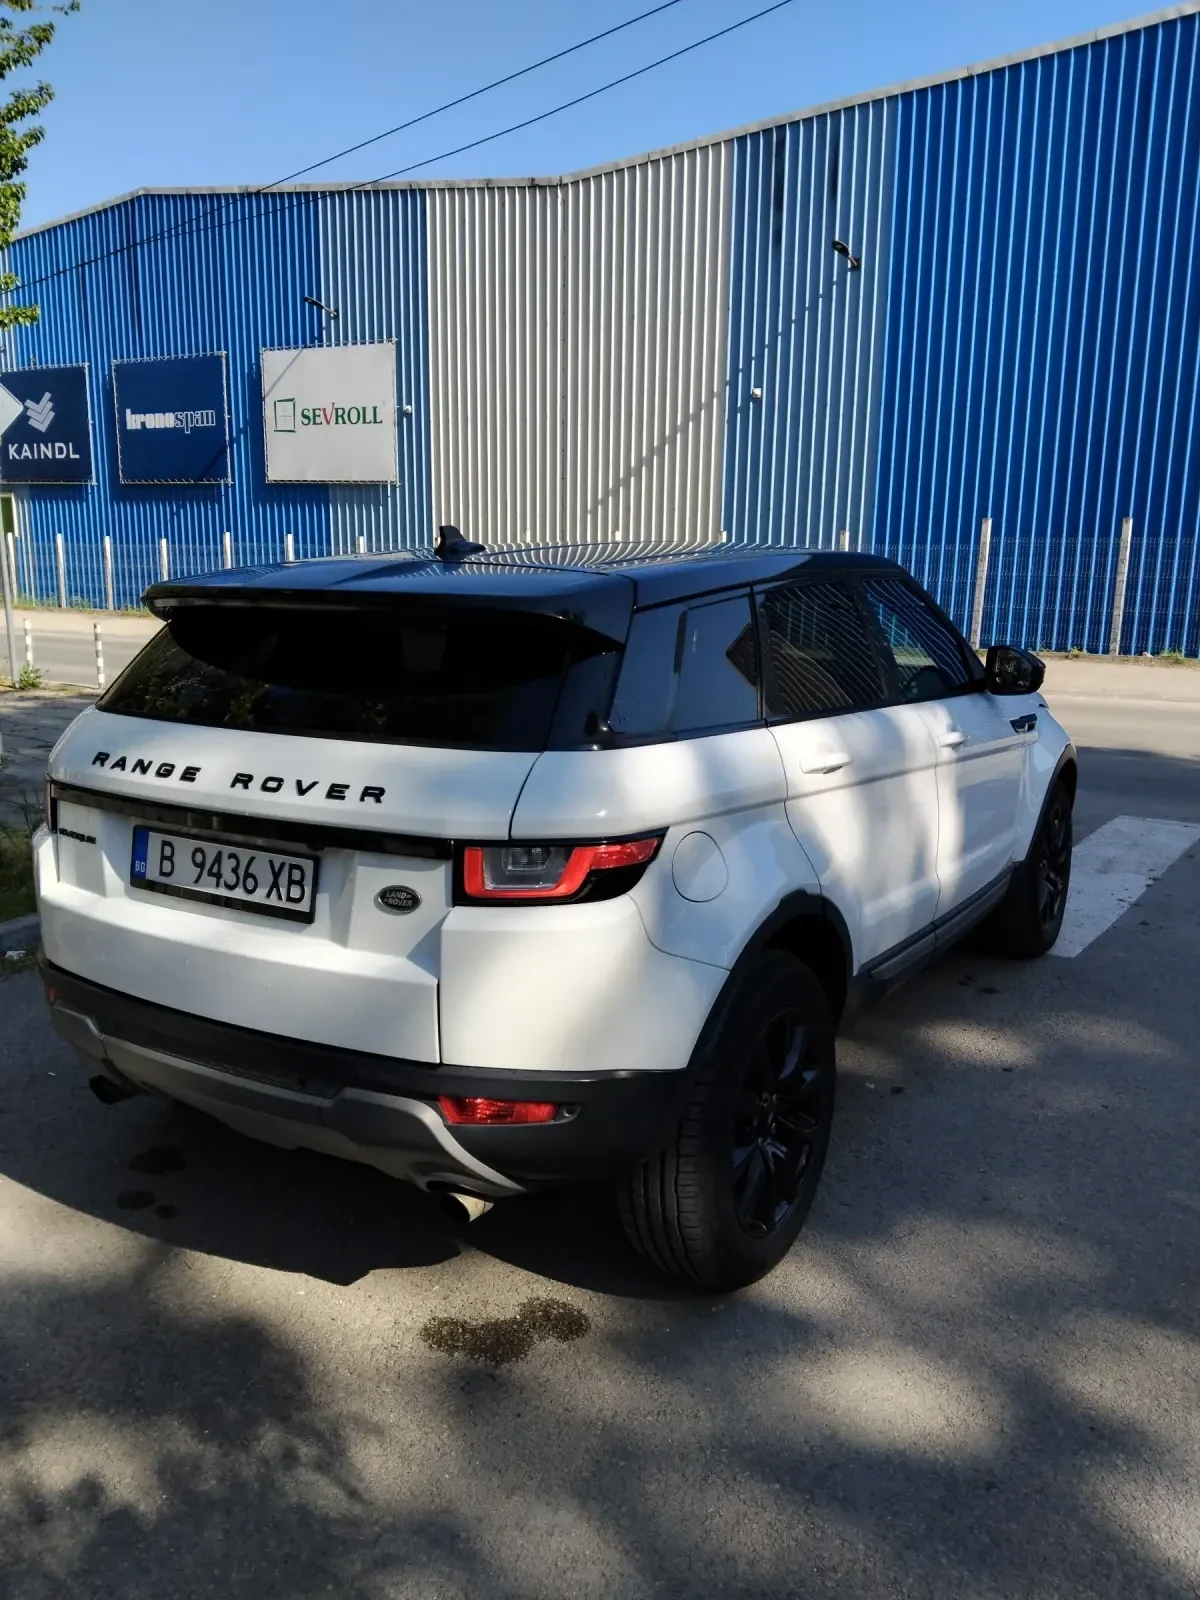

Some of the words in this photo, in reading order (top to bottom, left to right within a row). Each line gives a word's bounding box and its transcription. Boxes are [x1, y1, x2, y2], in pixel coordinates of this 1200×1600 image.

[125, 408, 216, 433] kronospan
[301, 402, 383, 426] SEVROLL
[8, 442, 80, 460] KAINDL
[91, 751, 202, 783] RANGE
[230, 772, 387, 804] ROVER
[134, 860, 147, 873] BG
[159, 840, 175, 878] B
[191, 847, 259, 895] 9436
[265, 859, 306, 904] XB
